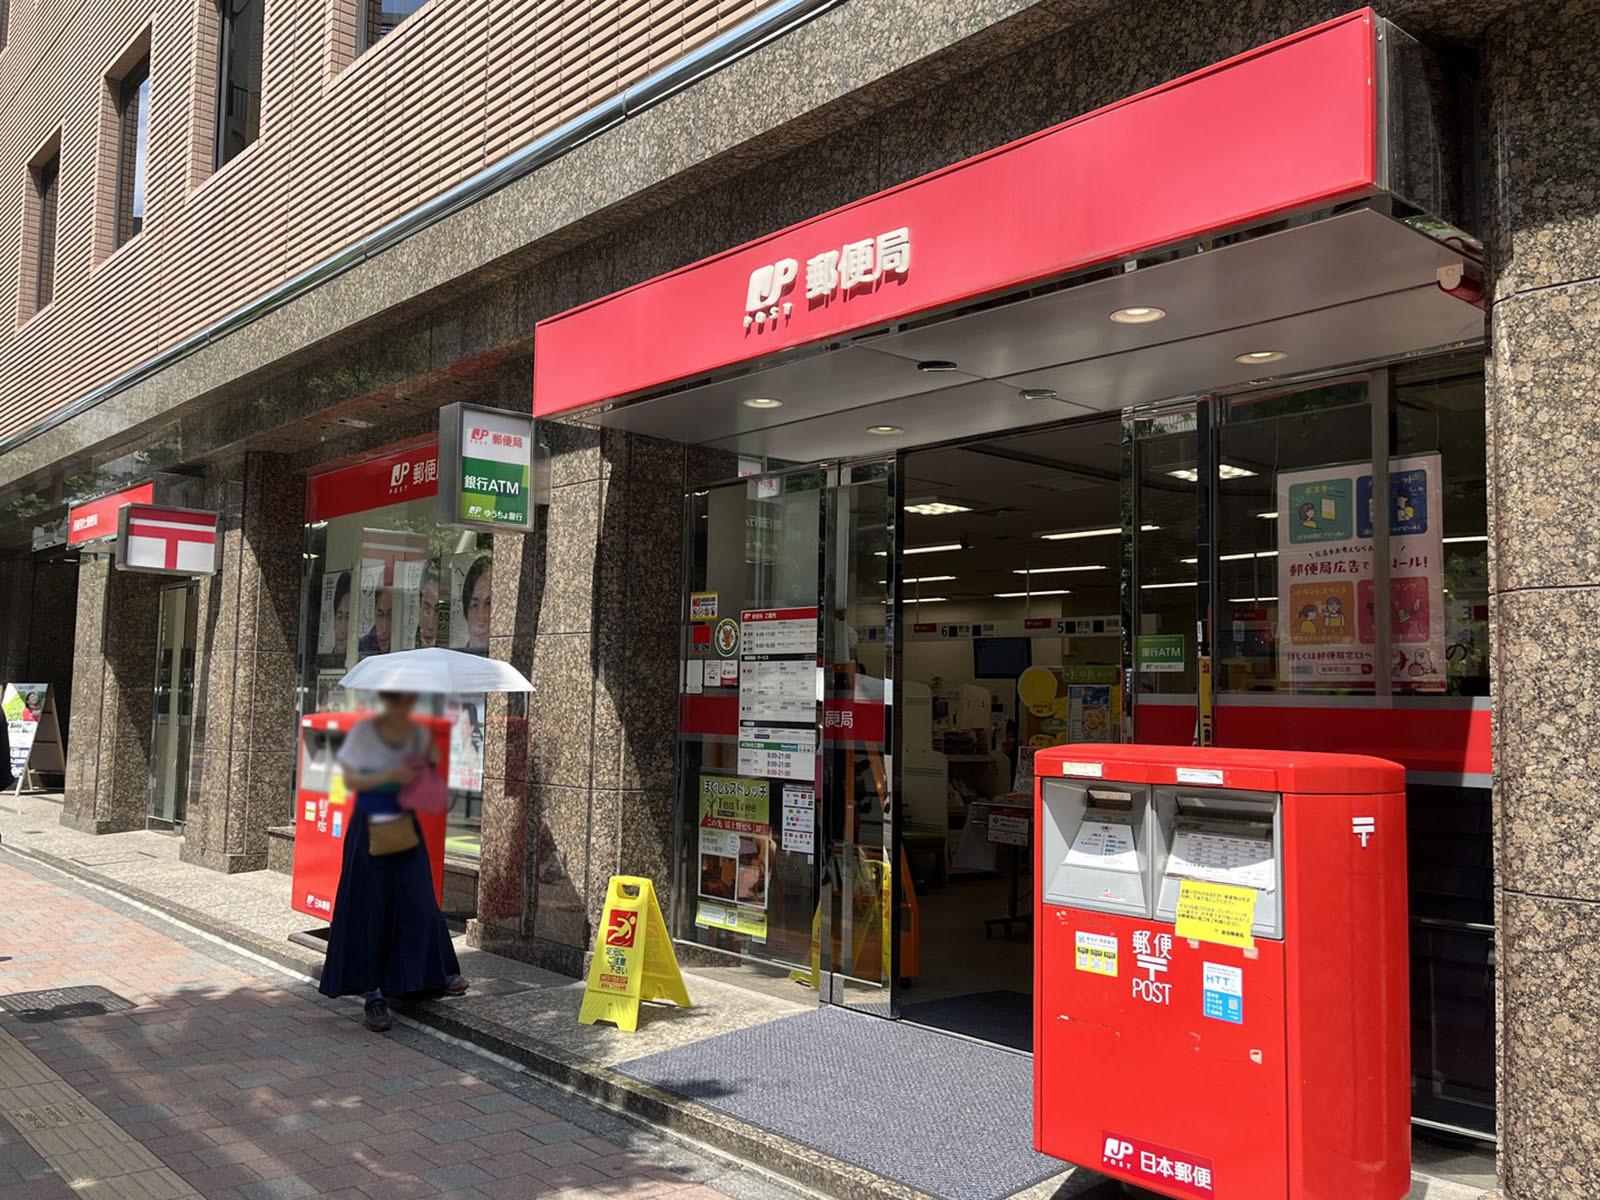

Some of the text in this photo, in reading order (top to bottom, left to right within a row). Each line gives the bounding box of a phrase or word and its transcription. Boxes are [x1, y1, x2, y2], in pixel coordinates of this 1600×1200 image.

[745, 227, 911, 312] JP 郵便局
[743, 301, 794, 328] POST
[492, 433, 523, 448] 郵便局
[390, 458, 440, 487] JP 郵便
[464, 475, 519, 495] 銀行ATM
[484, 509, 523, 521] ゆうちょ銀行
[941, 626, 948, 637] 6
[1057, 621, 1064, 633] 5
[1142, 647, 1181, 657] 銀行ATM
[767, 752, 792, 760] 8:00-21:00
[1132, 930, 1173, 960] 郵便
[607, 956, 627, 966] ご注意
[609, 965, 628, 975] 下さい
[1206, 974, 1230, 987] HTT
[1132, 978, 1173, 1005] POST
[1103, 1156, 1132, 1170] POST
[1104, 1138, 1213, 1190] JP 日本郵便
